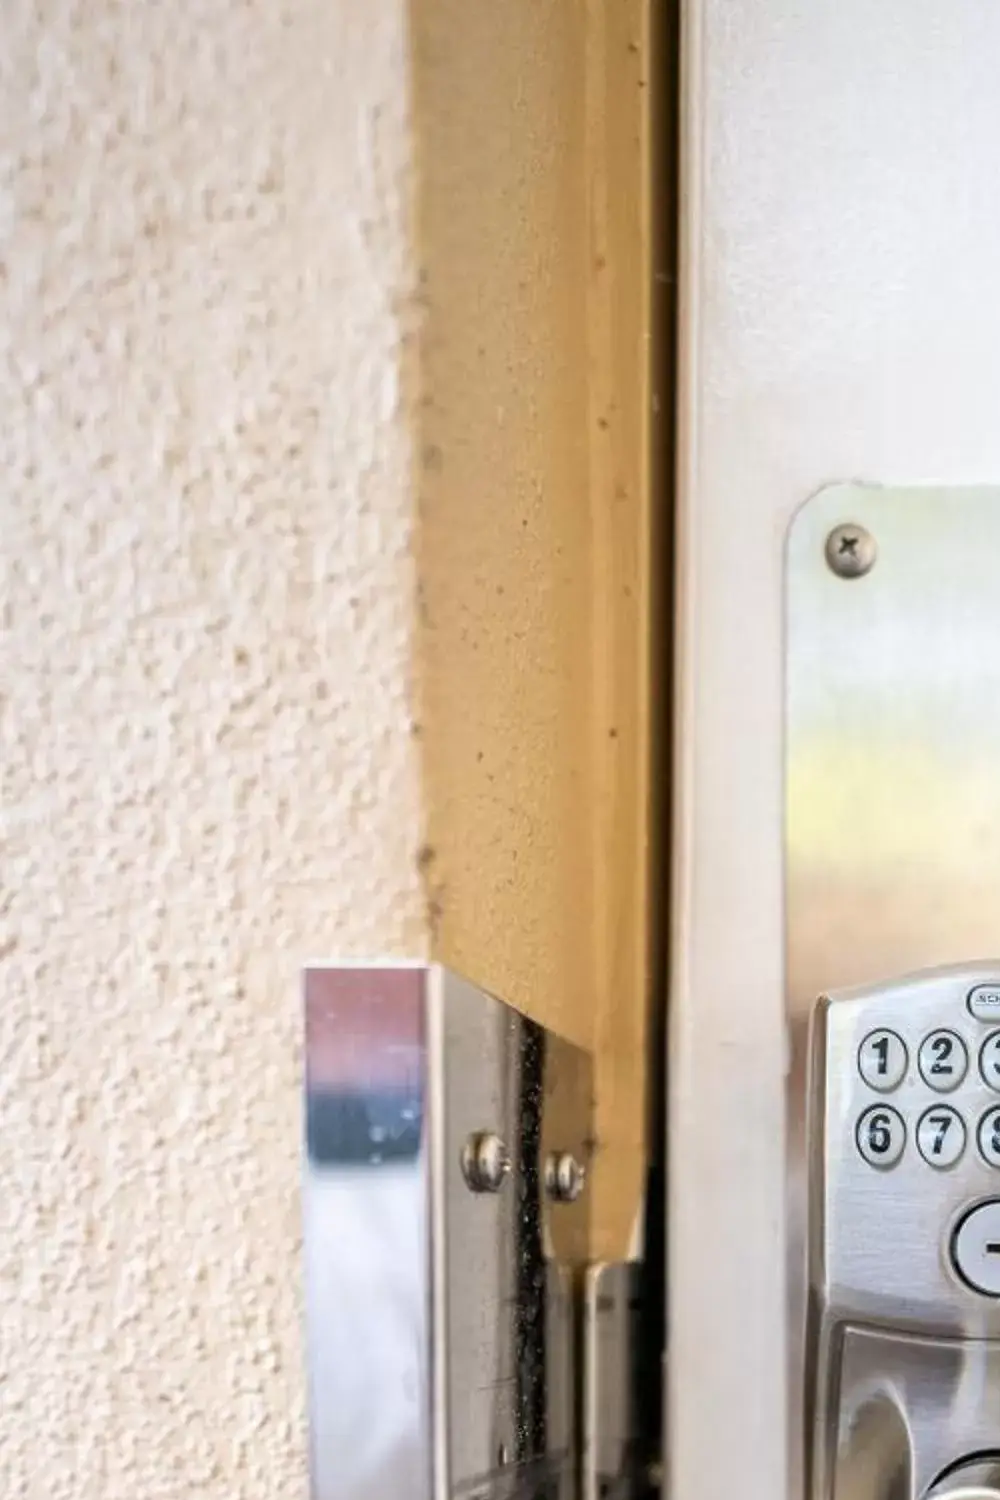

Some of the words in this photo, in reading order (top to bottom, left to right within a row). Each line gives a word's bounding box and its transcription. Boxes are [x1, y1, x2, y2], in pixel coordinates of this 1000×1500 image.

[871, 1037, 889, 1075] 1
[930, 1037, 953, 1075] 2
[868, 1114, 891, 1153] 6
[929, 1116, 952, 1154] 7
